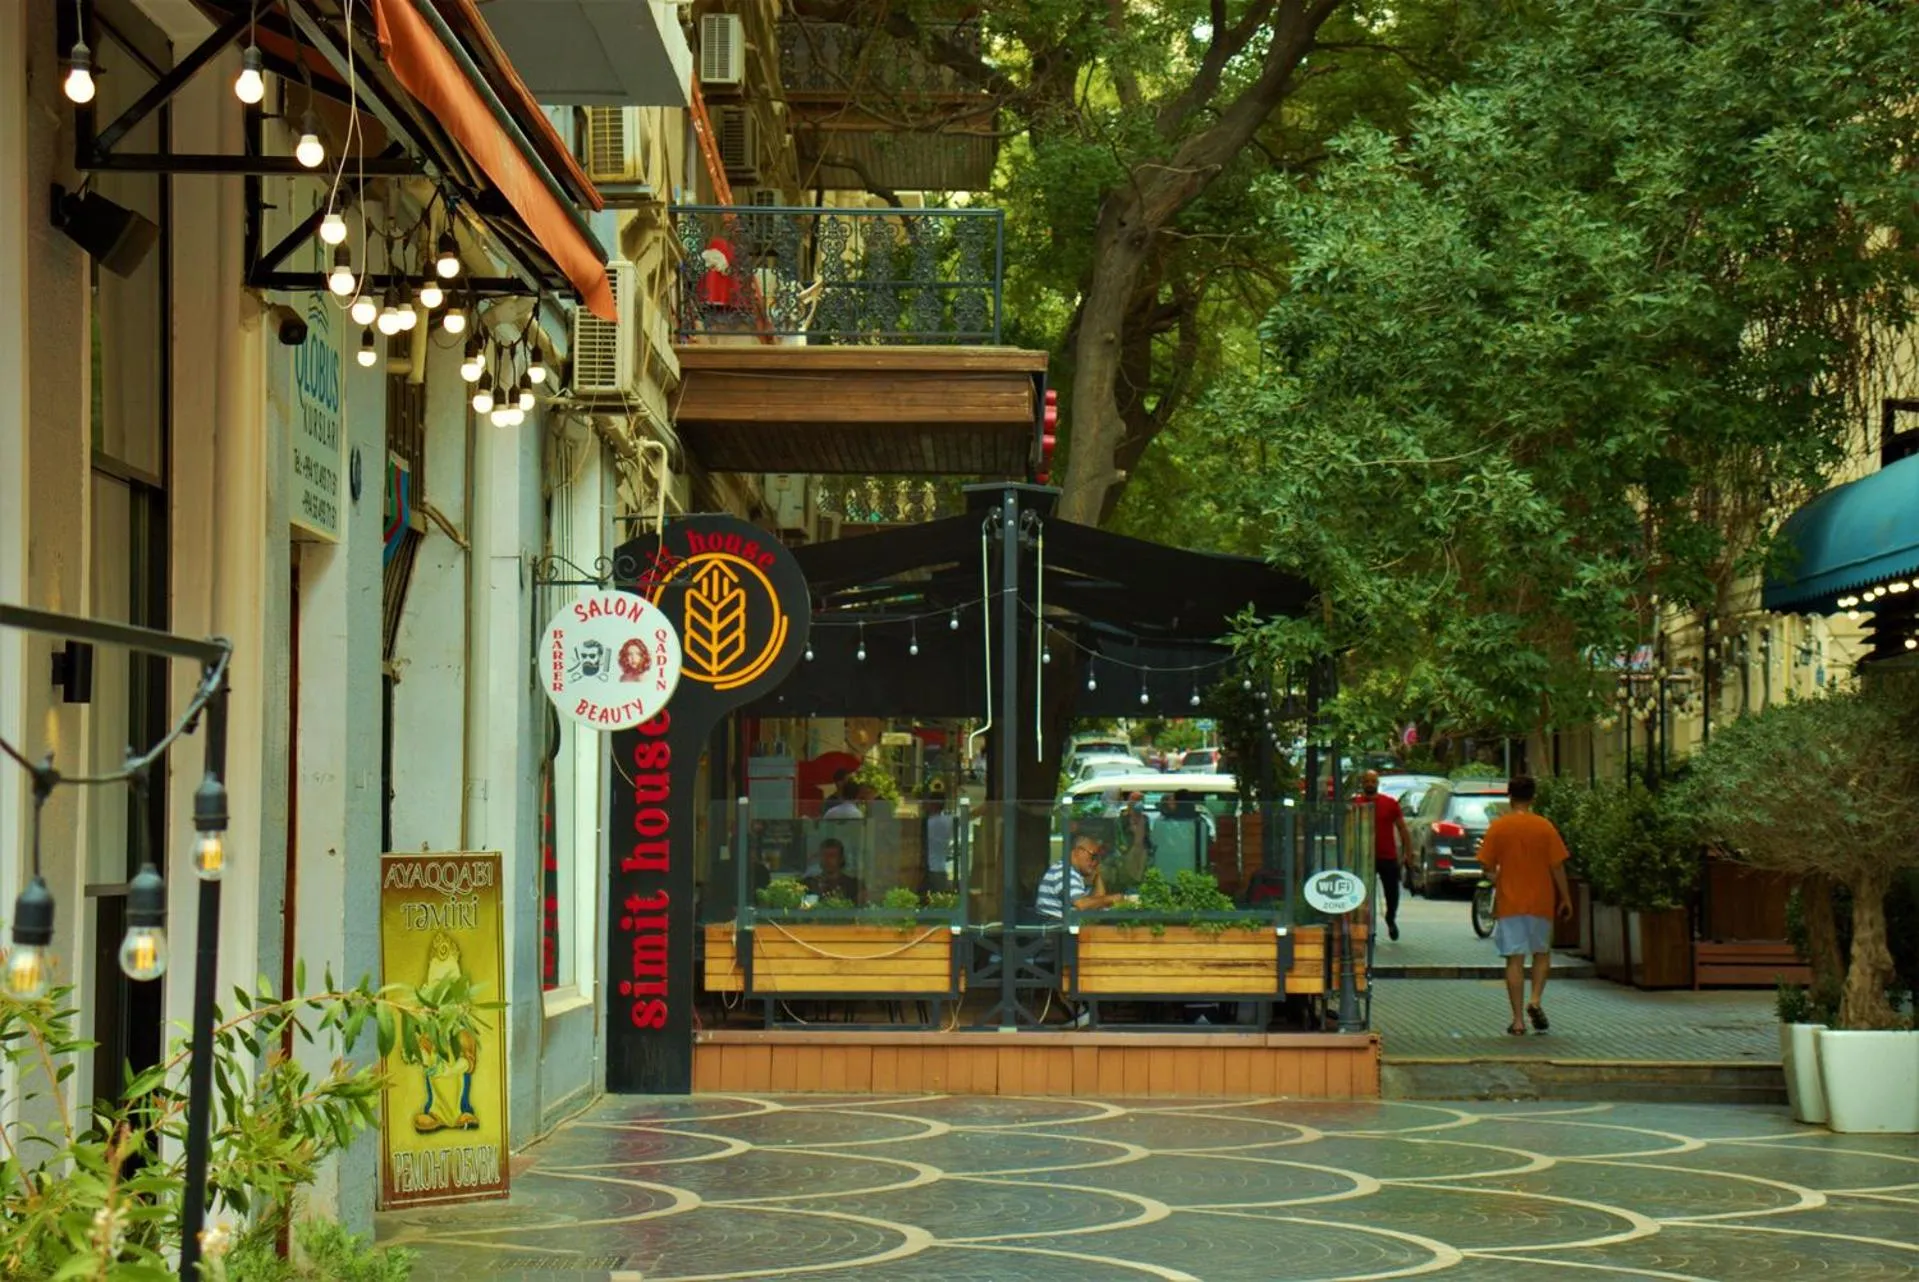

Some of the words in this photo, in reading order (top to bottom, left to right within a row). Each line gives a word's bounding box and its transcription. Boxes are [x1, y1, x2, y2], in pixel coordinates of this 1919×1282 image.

[685, 528, 777, 571] house
[574, 596, 644, 623] SALON
[552, 629, 564, 692] BARBER
[655, 628, 668, 691] QADIN
[575, 698, 644, 724] BEAUTY
[384, 861, 494, 896] AYAQQABI
[1323, 901, 1346, 910] ZONE
[618, 888, 670, 1030] simit
